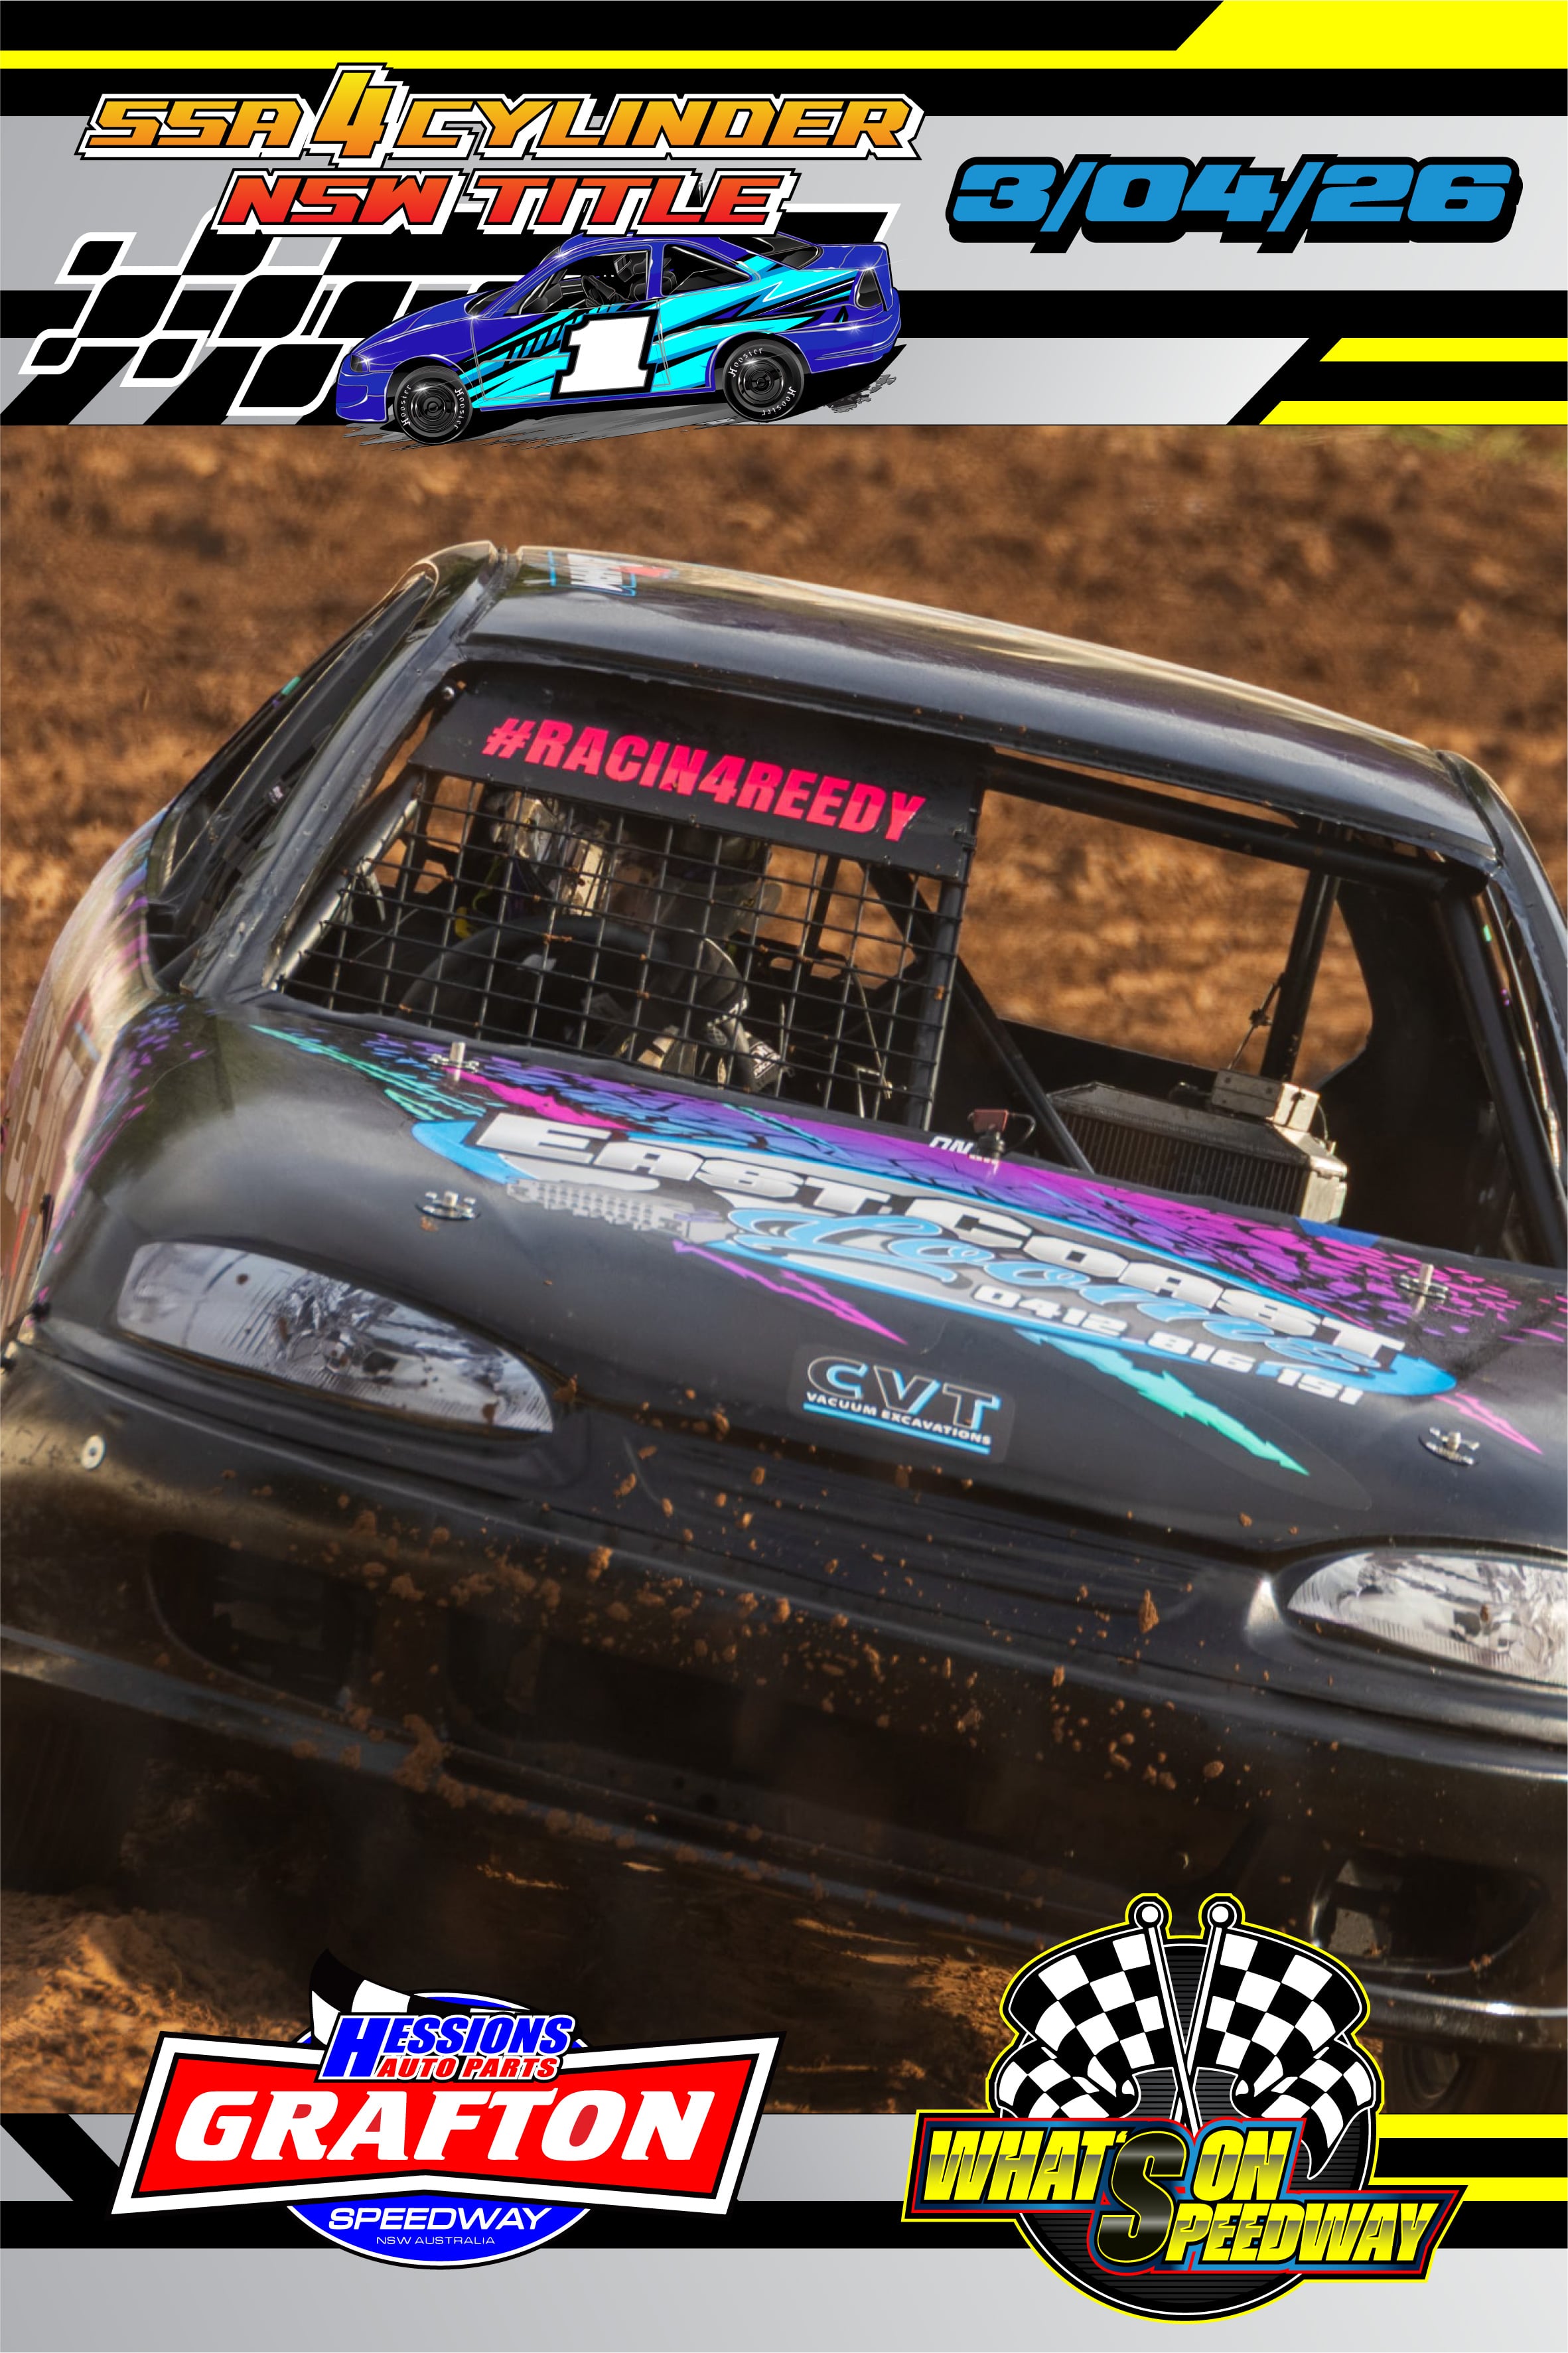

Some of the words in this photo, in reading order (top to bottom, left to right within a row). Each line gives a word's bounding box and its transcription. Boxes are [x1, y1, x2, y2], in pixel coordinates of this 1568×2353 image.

[481, 716, 926, 842] #RACIN4REEDY
[475, 1112, 892, 1214] EAST
[903, 1197, 1406, 1359] COAST
[808, 1355, 1002, 1431] CVT
[973, 1284, 1129, 1337] 0412
[1147, 1330, 1257, 1373] 816
[1277, 1367, 1364, 1406] 151
[806, 1391, 878, 1416] VACUUM
[881, 1409, 993, 1446] EXCAVATIONS
